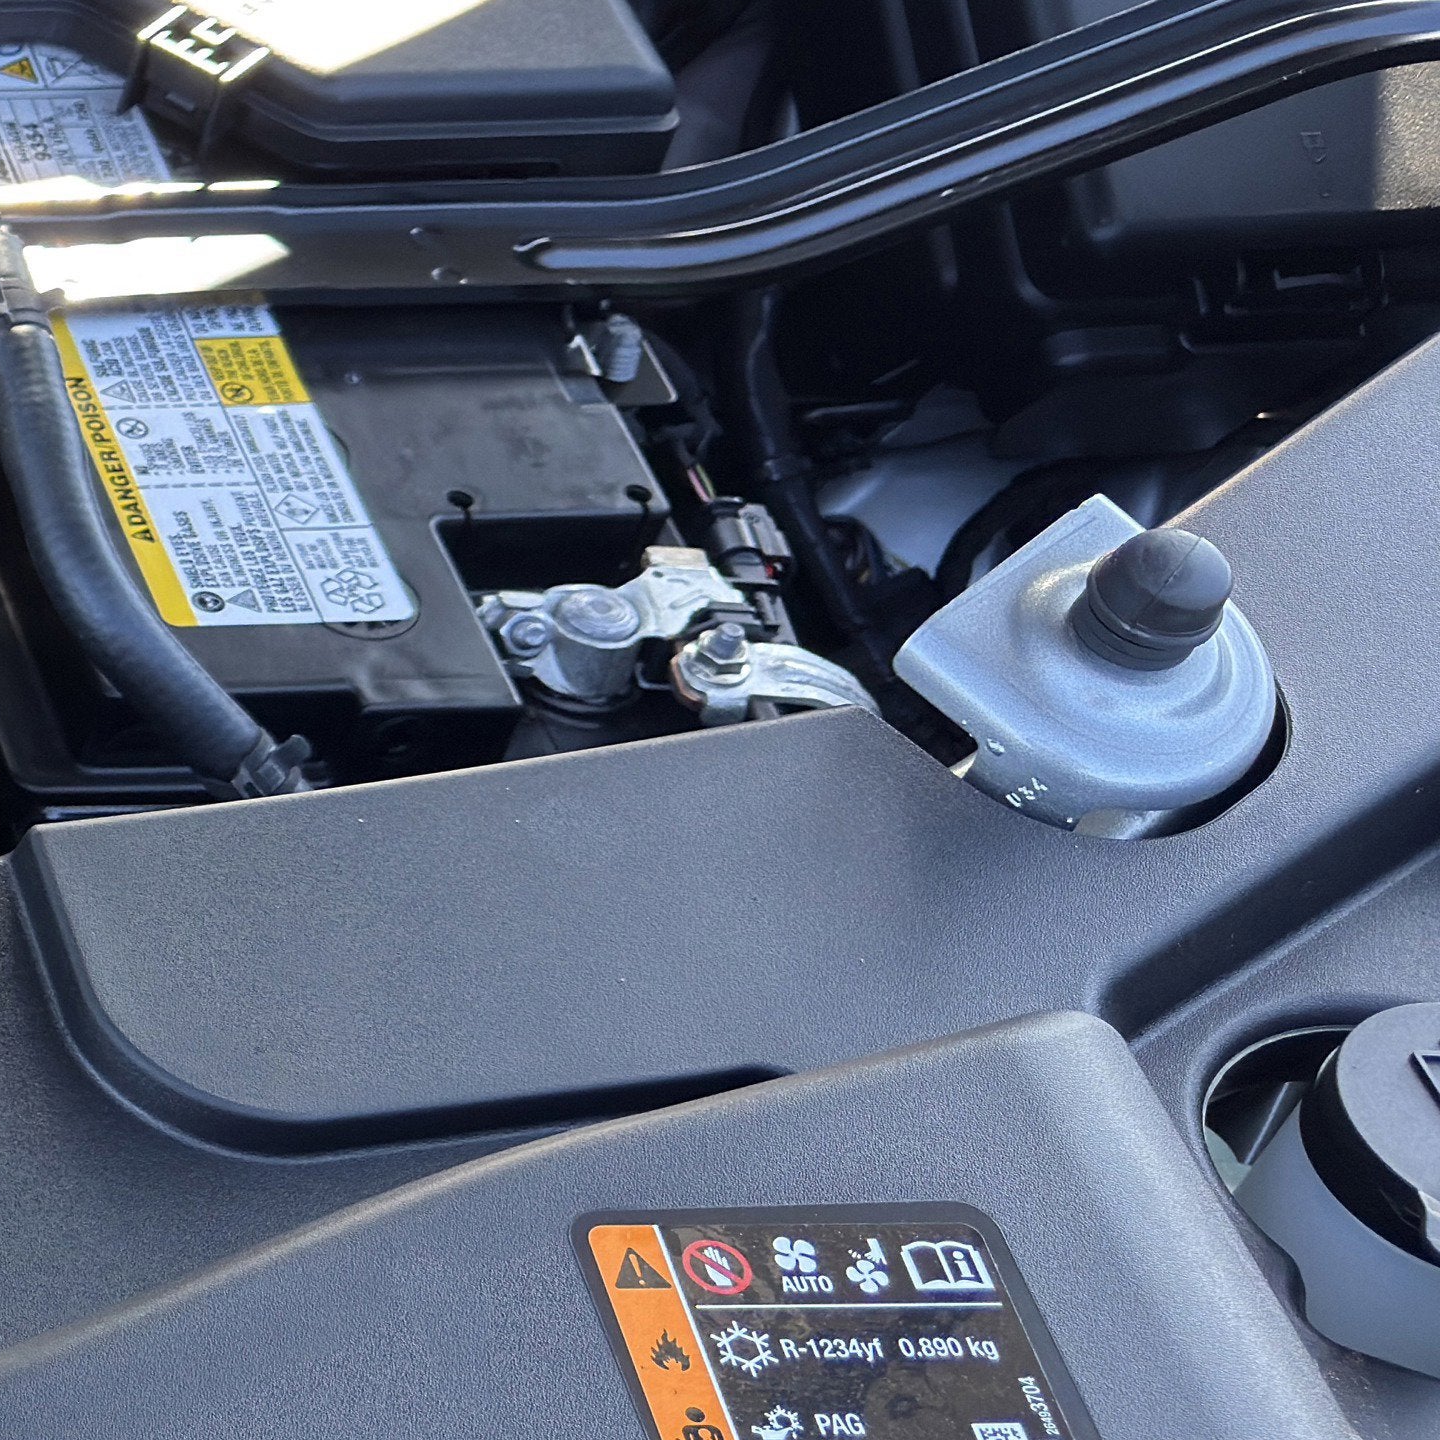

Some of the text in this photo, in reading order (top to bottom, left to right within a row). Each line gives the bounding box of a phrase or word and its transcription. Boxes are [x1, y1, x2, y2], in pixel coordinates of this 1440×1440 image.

[66, 376, 152, 527] DANGER/POISON
[782, 1275, 834, 1293] AUTO
[779, 1336, 1000, 1363] R-1234yf 0.890 kg
[814, 1413, 867, 1437] PAG
